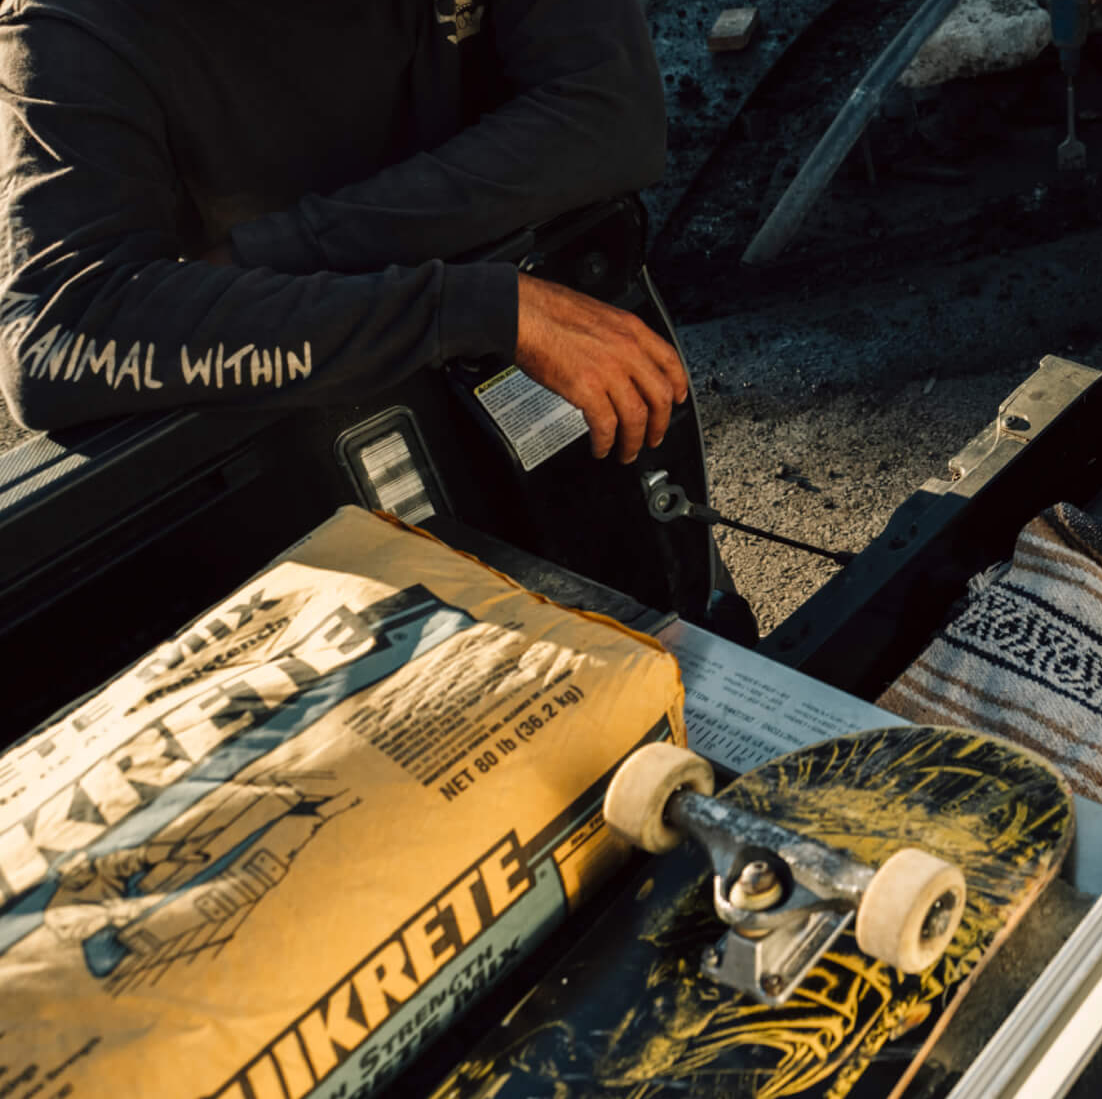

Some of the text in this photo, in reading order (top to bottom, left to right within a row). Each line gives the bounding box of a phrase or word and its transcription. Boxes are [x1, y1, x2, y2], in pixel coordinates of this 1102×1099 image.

[21, 323, 312, 392] ANIMAL WITHIN
[439, 683, 586, 802] NET 80 lb (36.2 kg)
